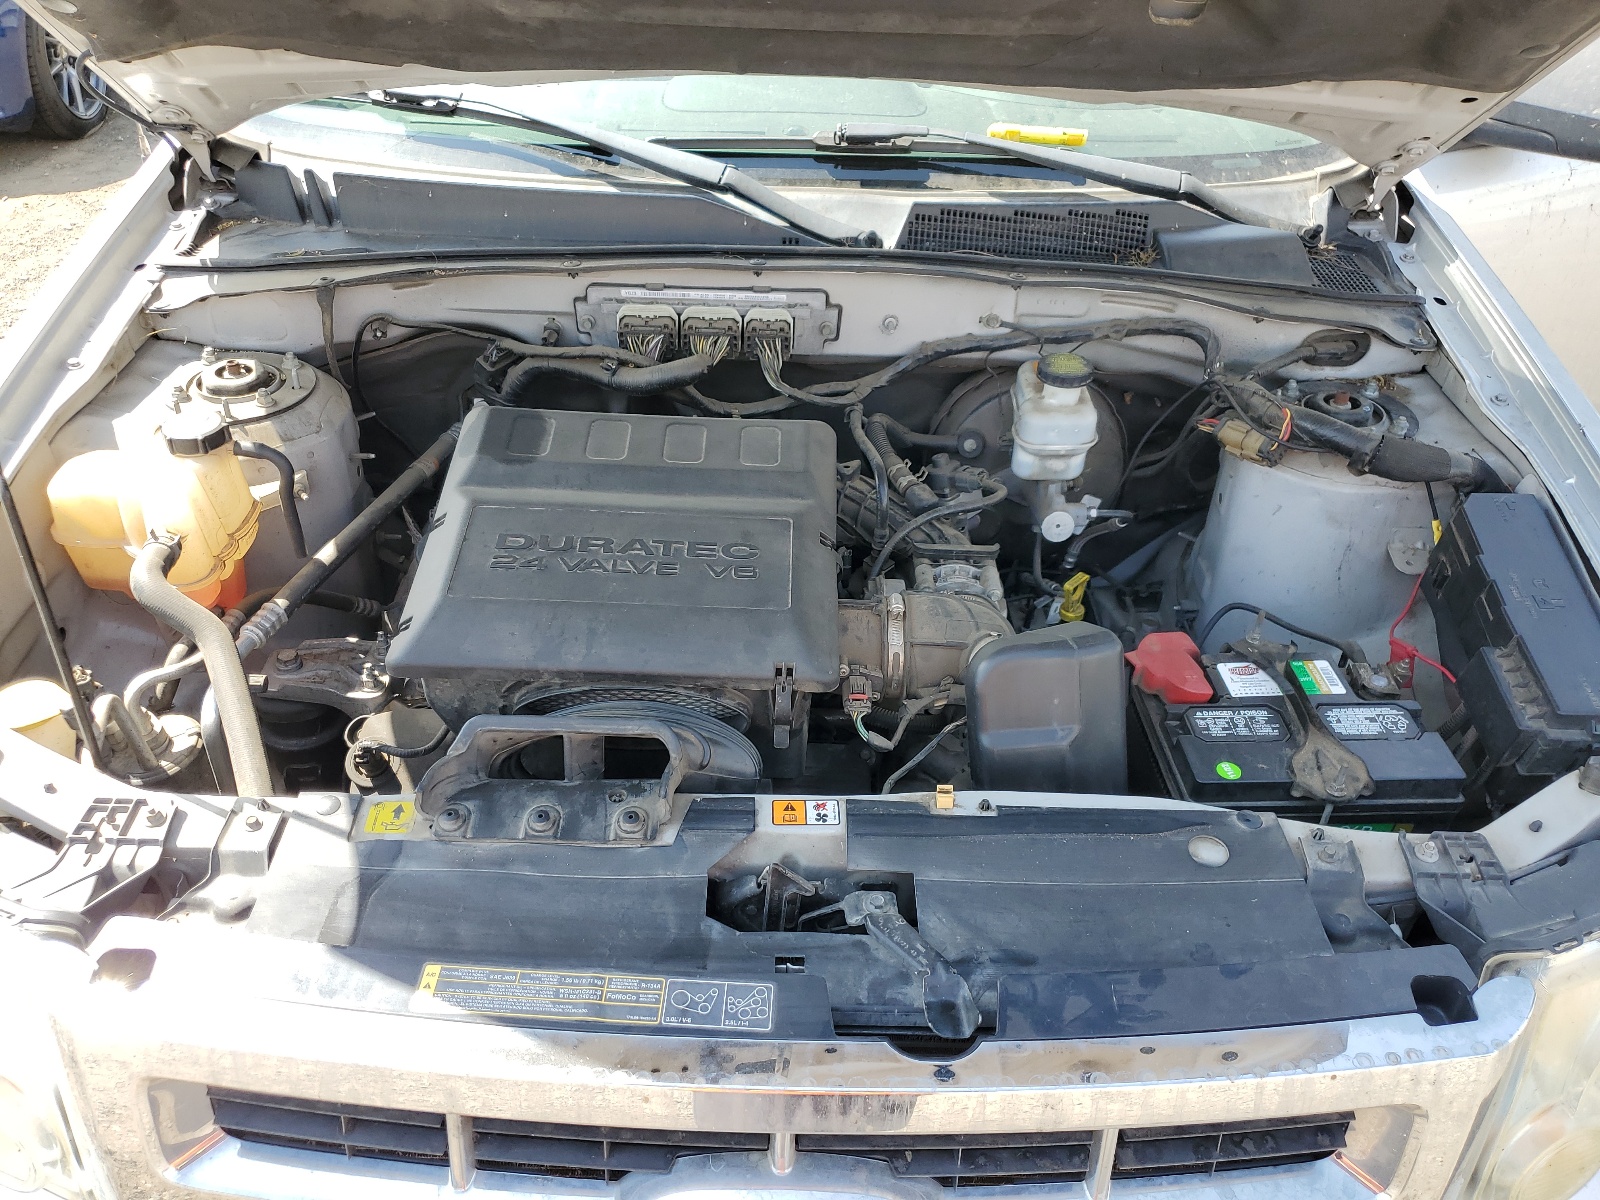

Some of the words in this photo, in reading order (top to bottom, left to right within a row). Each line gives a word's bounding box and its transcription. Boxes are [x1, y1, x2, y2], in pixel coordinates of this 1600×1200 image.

[494, 532, 760, 560] DURATEC
[488, 553, 547, 571] 24
[557, 556, 680, 577] VALVE
[703, 563, 759, 580] V6
[606, 993, 637, 1001] FoMoCo
